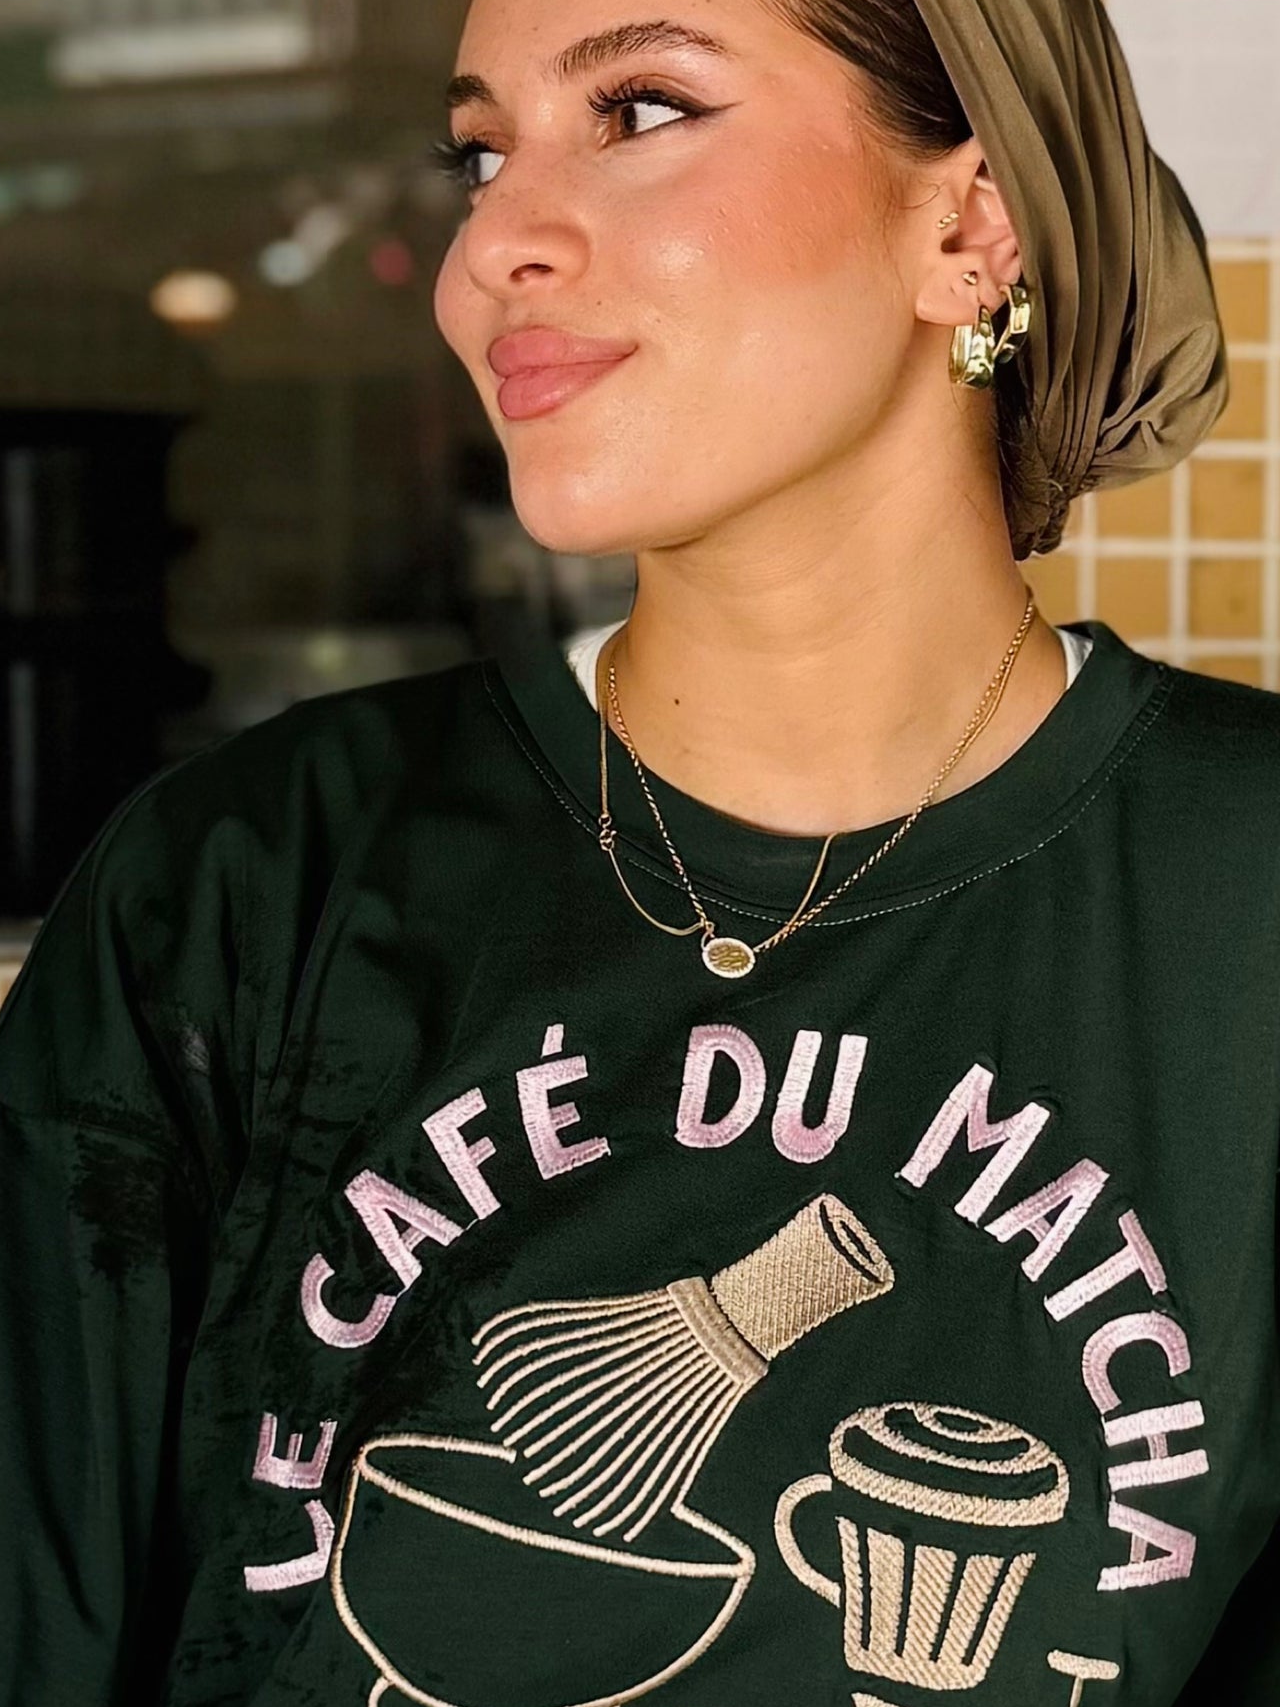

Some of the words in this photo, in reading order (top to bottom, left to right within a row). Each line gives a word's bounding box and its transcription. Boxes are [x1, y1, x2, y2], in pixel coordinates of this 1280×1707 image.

[244, 1410, 336, 1593] LE
[300, 1024, 612, 1349] CAFÉ
[673, 1024, 868, 1163] DU
[894, 1063, 1210, 1592] MATCHA
